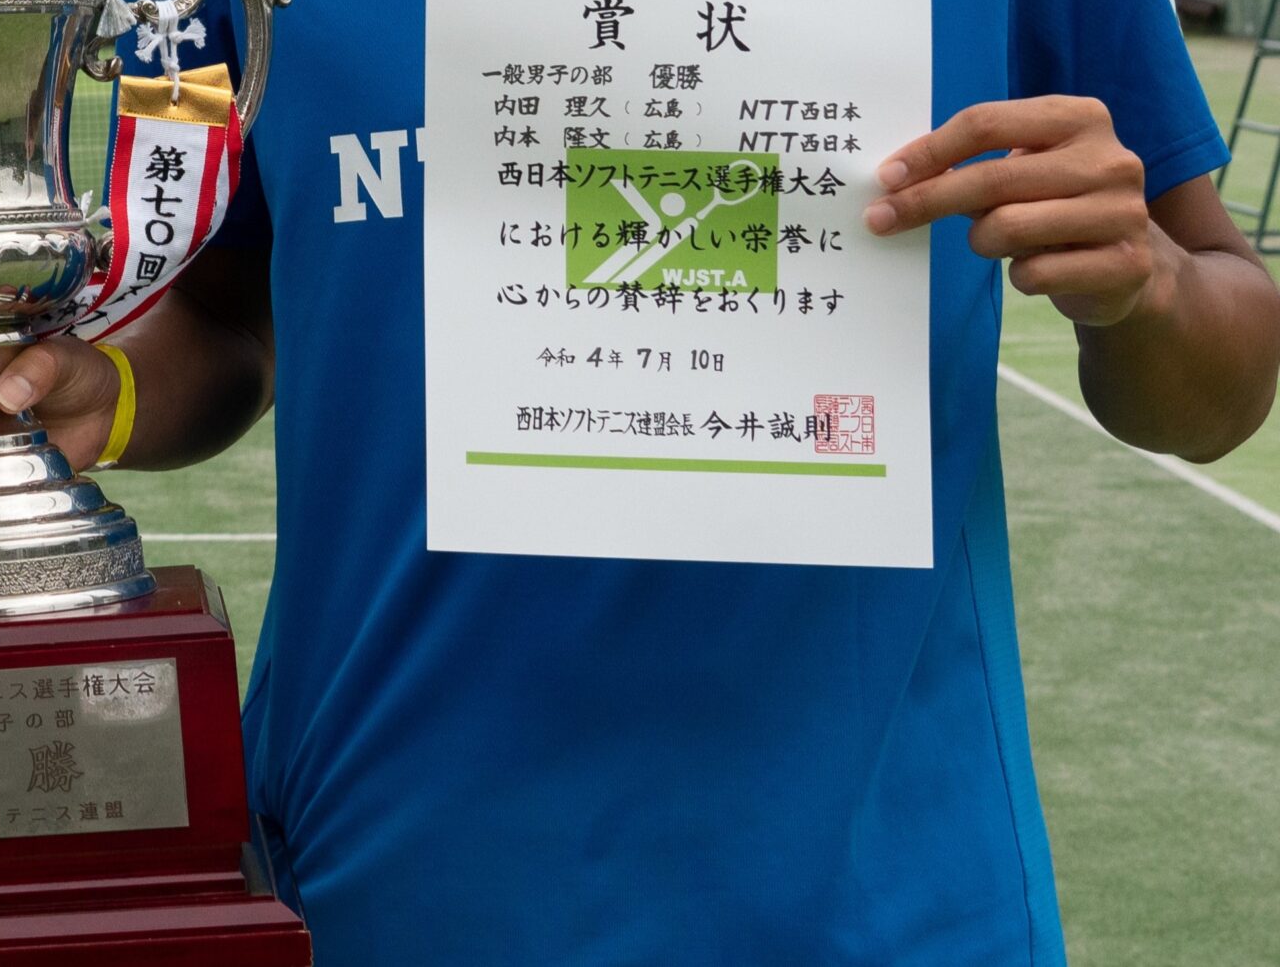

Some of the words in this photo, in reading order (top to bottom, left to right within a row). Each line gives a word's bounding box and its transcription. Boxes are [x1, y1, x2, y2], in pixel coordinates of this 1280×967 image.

[482, 63, 613, 85] 一般男子の部
[648, 64, 703, 90] 優勝
[494, 94, 540, 116] 内田
[564, 96, 610, 118] 理久
[739, 99, 860, 121] NTT西日本
[494, 125, 540, 148] 内本
[563, 126, 611, 150] 隆文
[739, 131, 861, 153] NTT西日本
[330, 128, 425, 223] N
[498, 160, 846, 197] 西日本ソフトテニス選手権大会
[500, 219, 843, 254] における輝かしい栄誉に
[662, 268, 747, 288] WJST.A
[497, 280, 844, 315] 心からの賛辞をおくります
[517, 406, 694, 436] 西日本ソフトテニス連盟会長
[701, 411, 832, 443] 今井誠則
